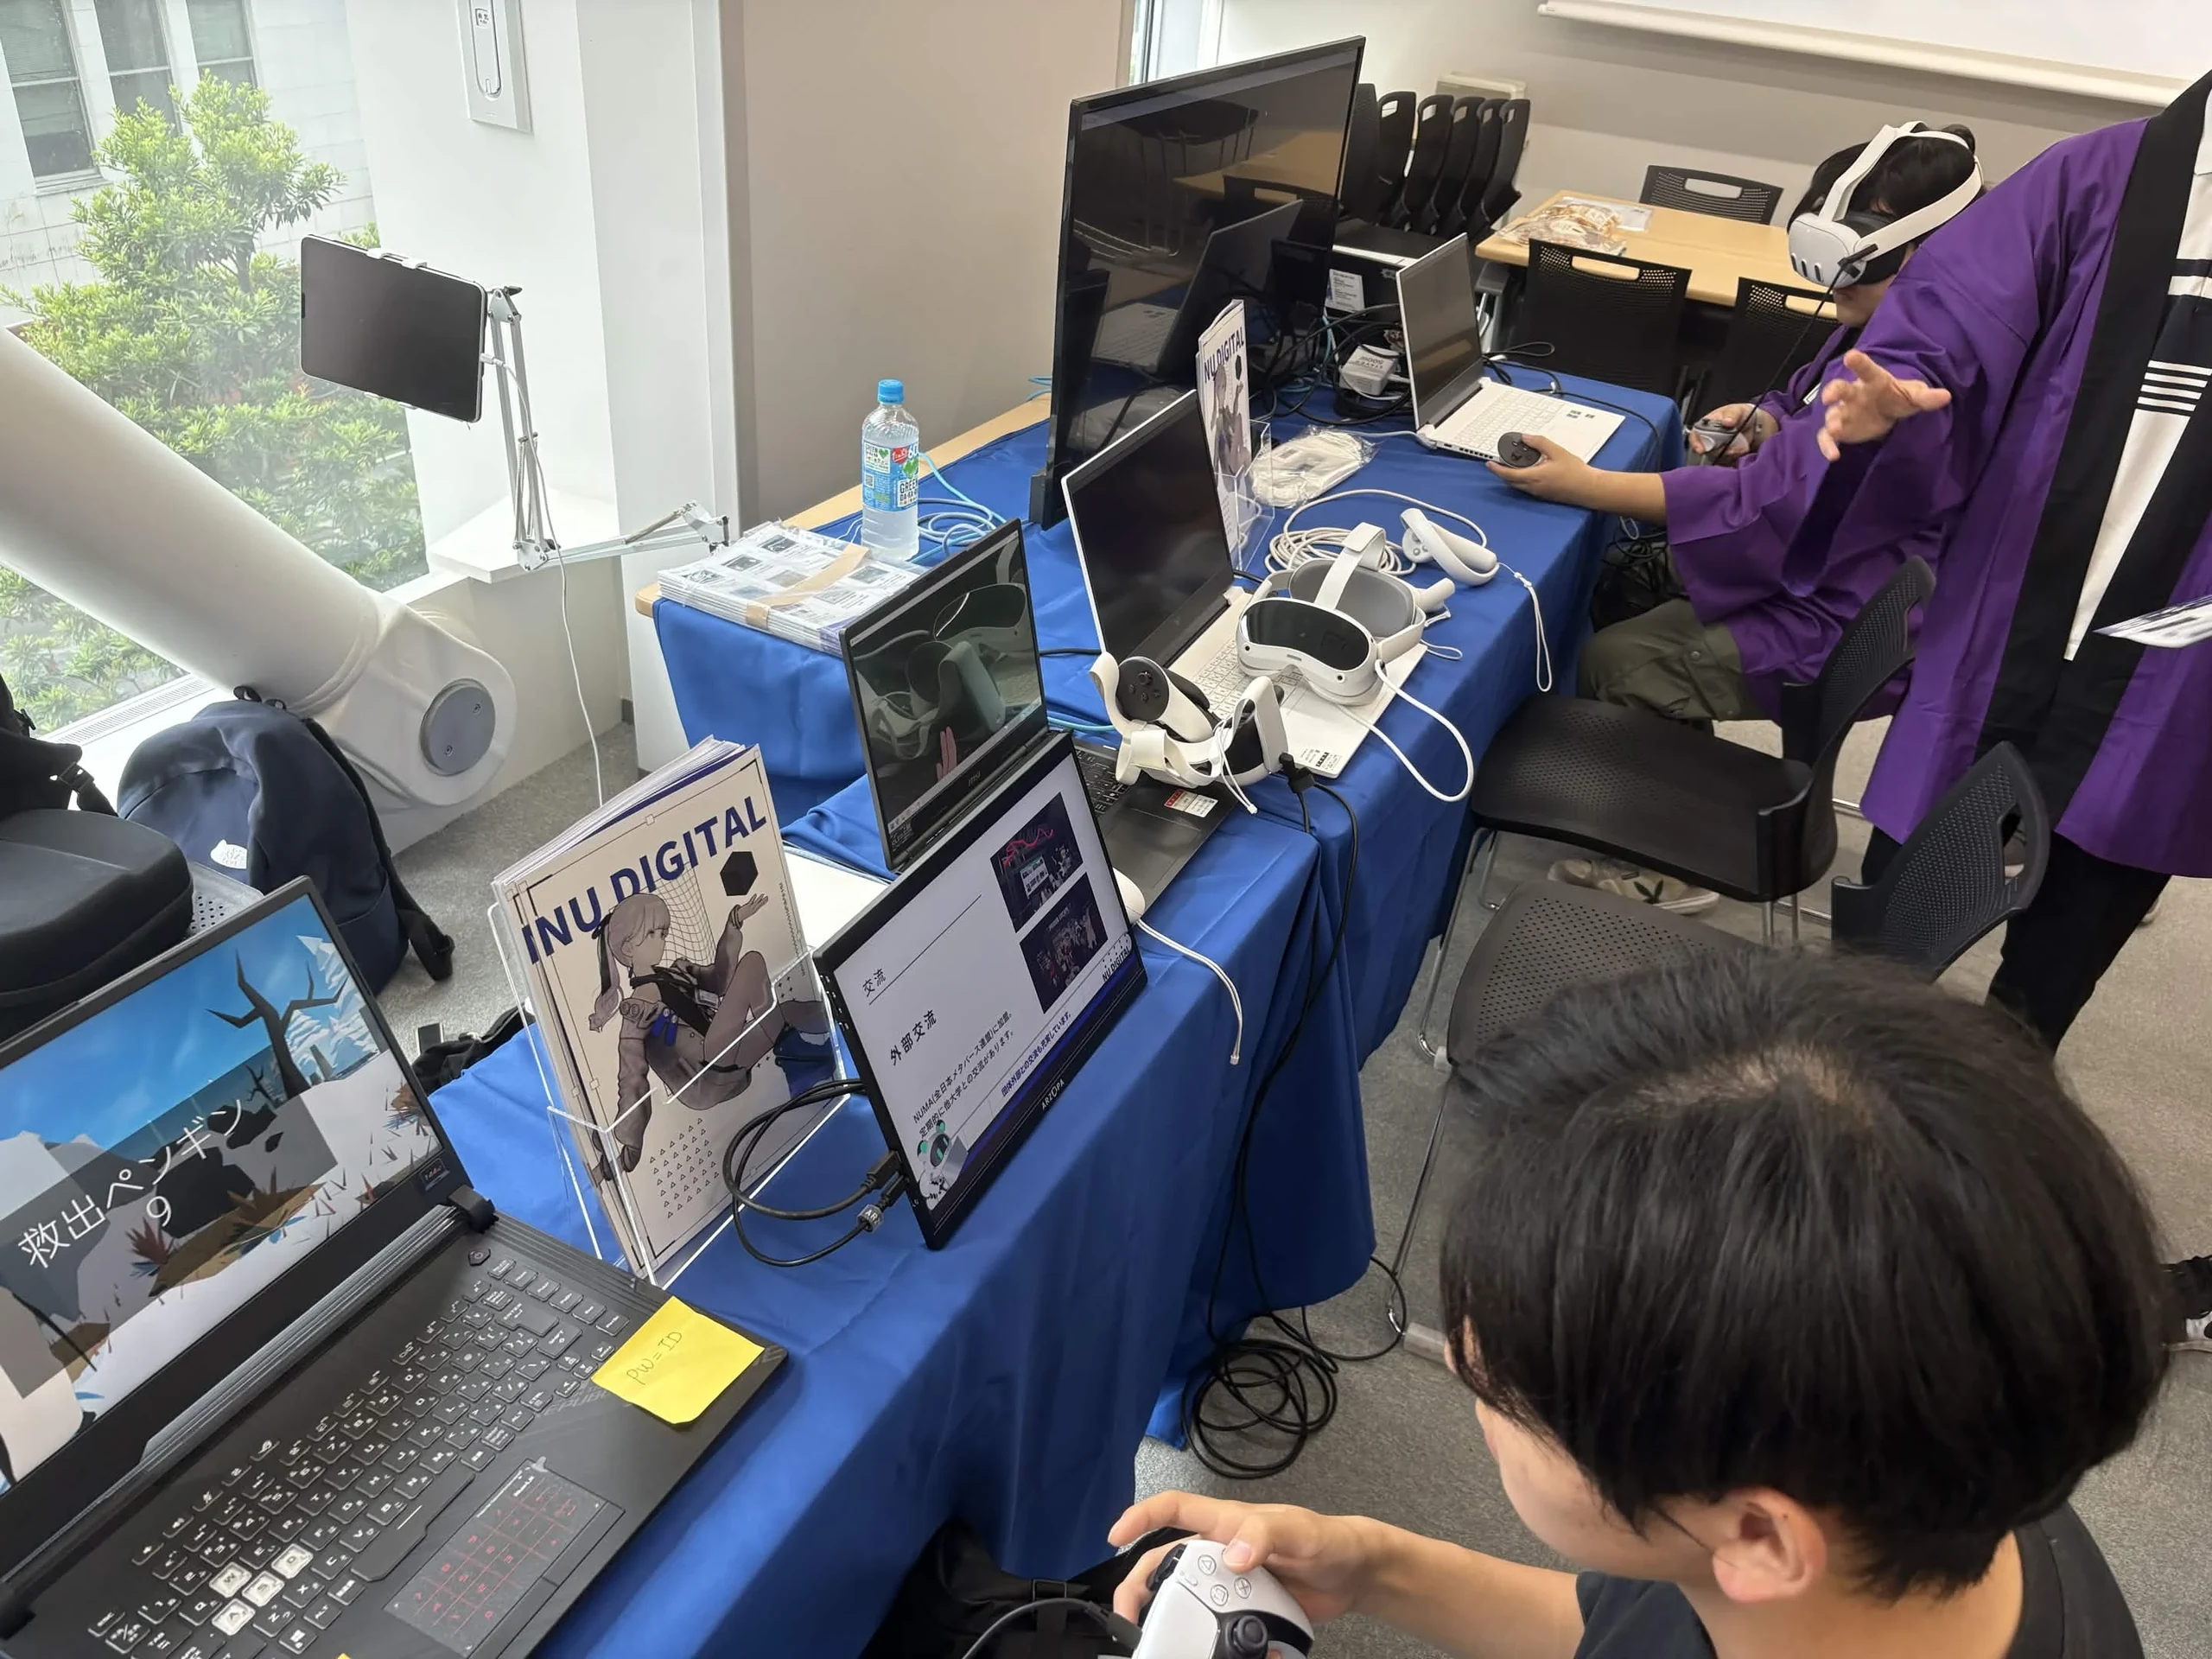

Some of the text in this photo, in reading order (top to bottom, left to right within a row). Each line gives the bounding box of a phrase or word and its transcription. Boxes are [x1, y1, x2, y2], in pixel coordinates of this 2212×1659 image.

[1204, 326, 1245, 384] NU DIGITAL
[534, 886, 603, 957] NU
[609, 795, 767, 905] DIGITAL
[1110, 945, 1130, 972] DIGITAL
[862, 968, 887, 997] 交流
[889, 1009, 938, 1066] 外部交流
[1041, 1078, 1065, 1111] ARZOPA
[18, 1099, 242, 1268] 救出ペンギン
[145, 1196, 172, 1227] 9
